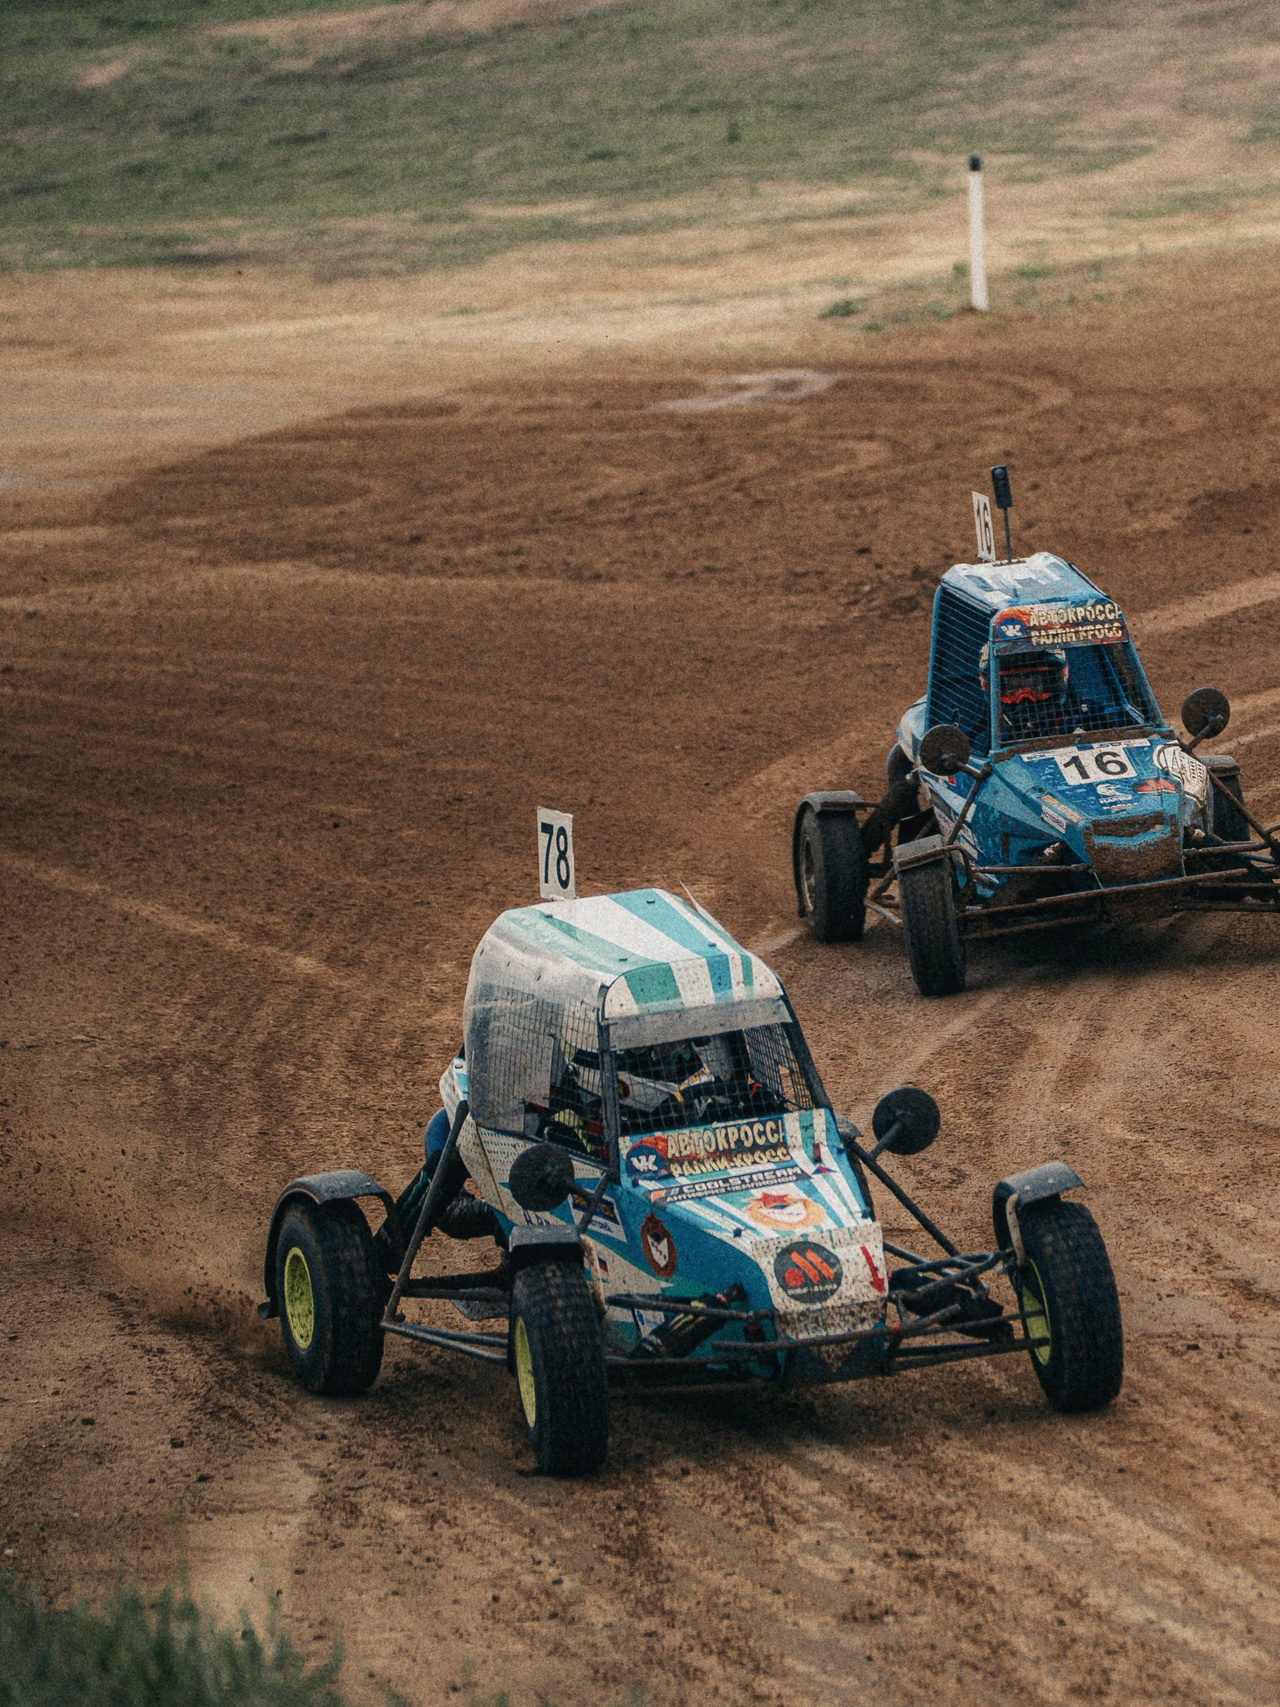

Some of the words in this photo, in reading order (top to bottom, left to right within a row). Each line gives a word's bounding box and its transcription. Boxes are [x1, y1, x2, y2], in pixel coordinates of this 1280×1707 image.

[977, 500, 993, 555] 16
[1063, 751, 1129, 780] 16
[541, 822, 570, 889] 78
[683, 1166, 802, 1194] COOLSTREAM
